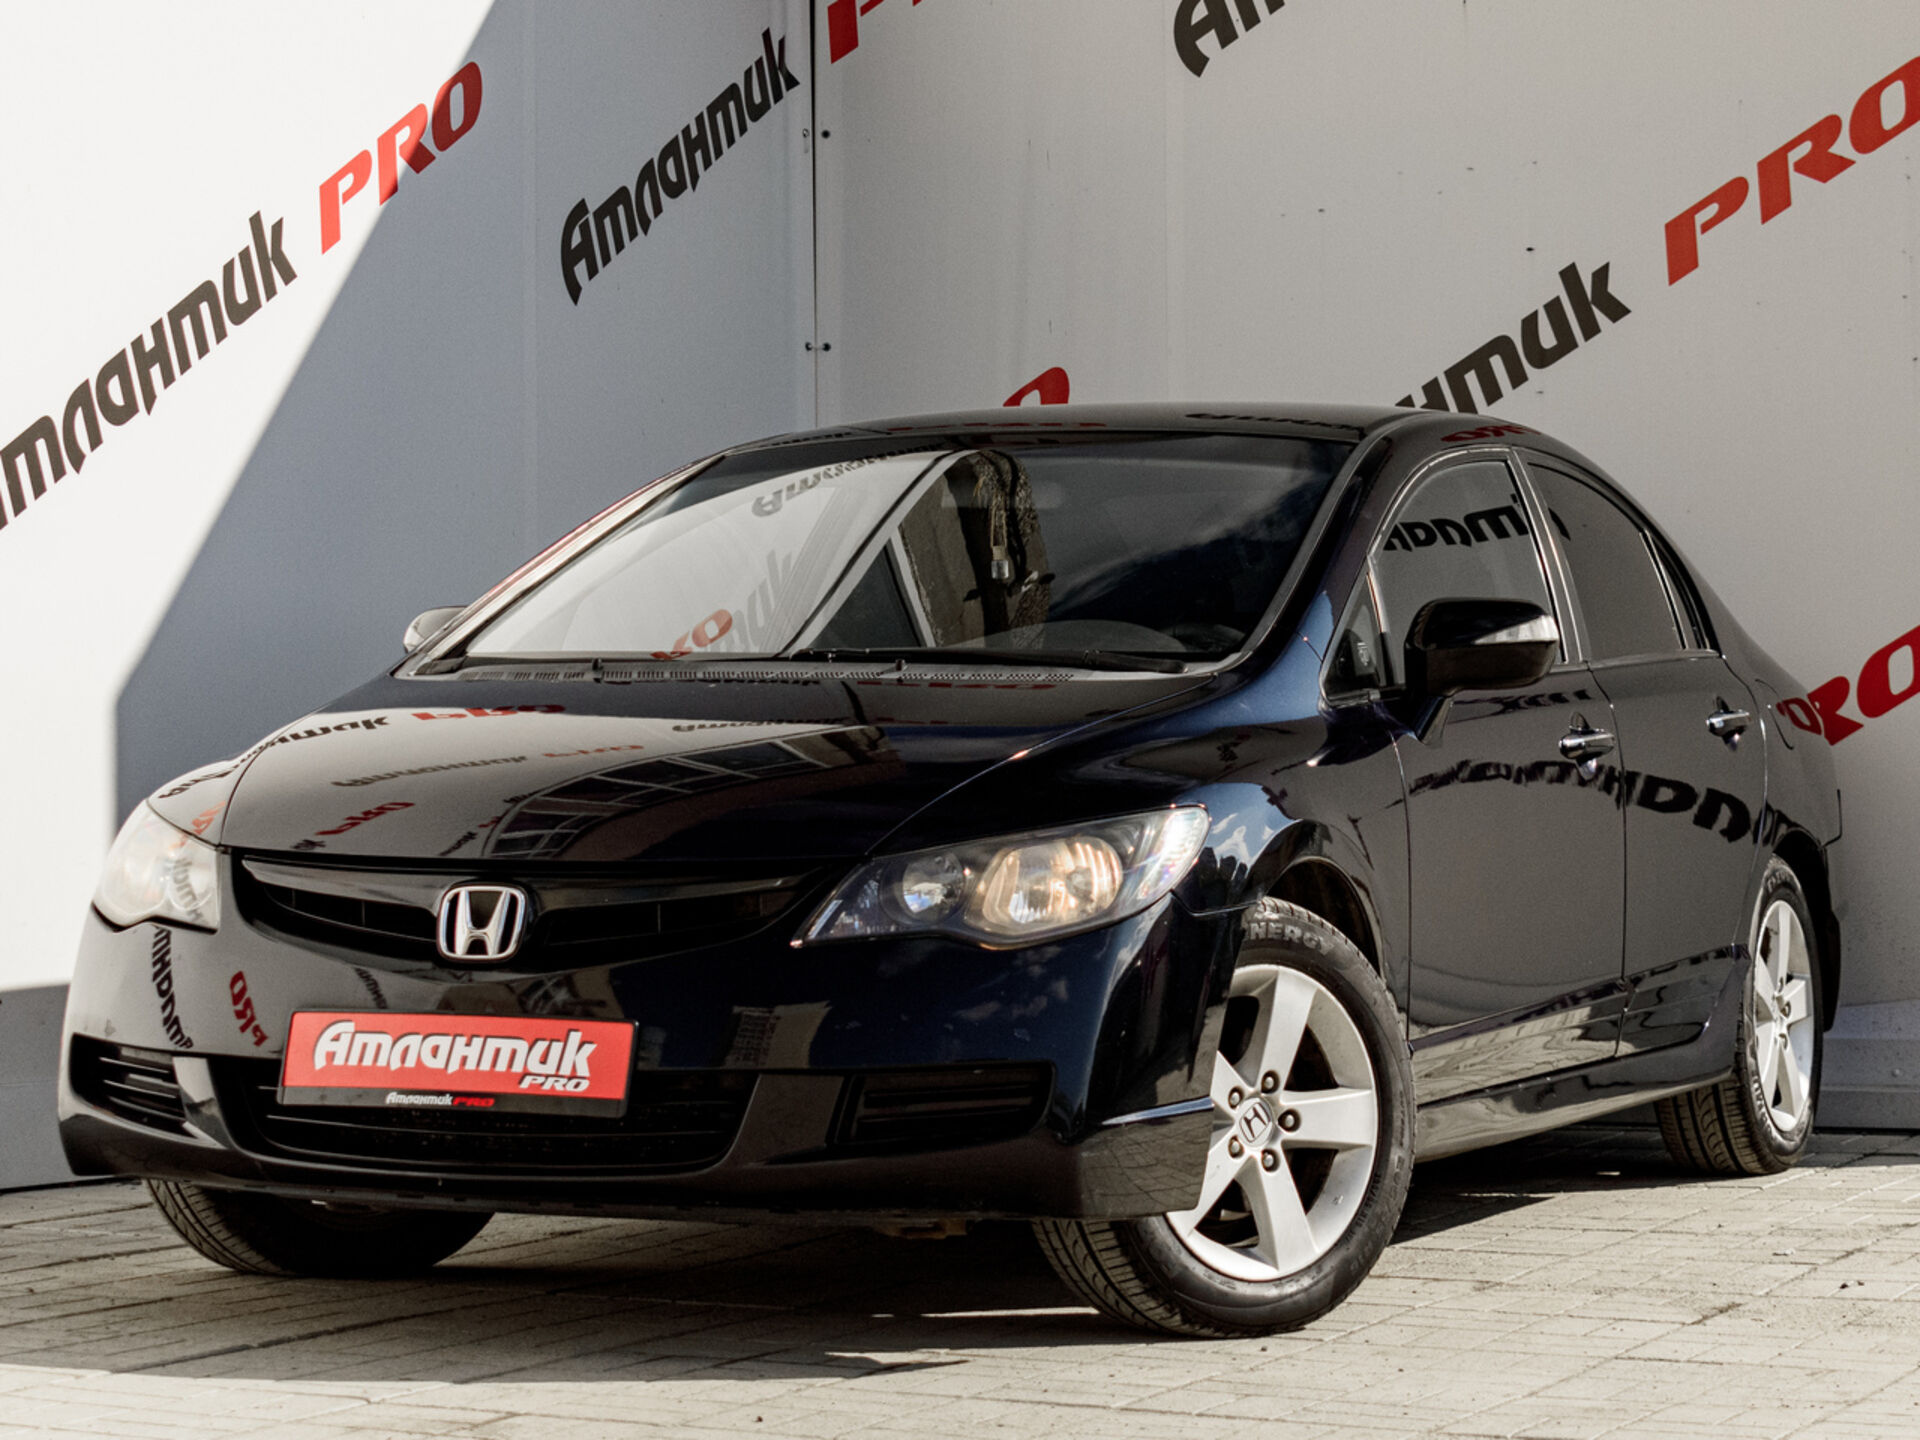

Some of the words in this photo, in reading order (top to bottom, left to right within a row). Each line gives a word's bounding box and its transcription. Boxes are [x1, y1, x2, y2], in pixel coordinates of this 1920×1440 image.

[560, 26, 801, 307] Атлантик
[1664, 55, 1920, 286] PRO
[0, 210, 298, 530] тлантик
[319, 60, 483, 255] PRO
[313, 1018, 598, 1078] Атлантик
[384, 1090, 454, 1107] Атлантик
[451, 1096, 496, 1108] PRO
[518, 1073, 591, 1093] PRO
